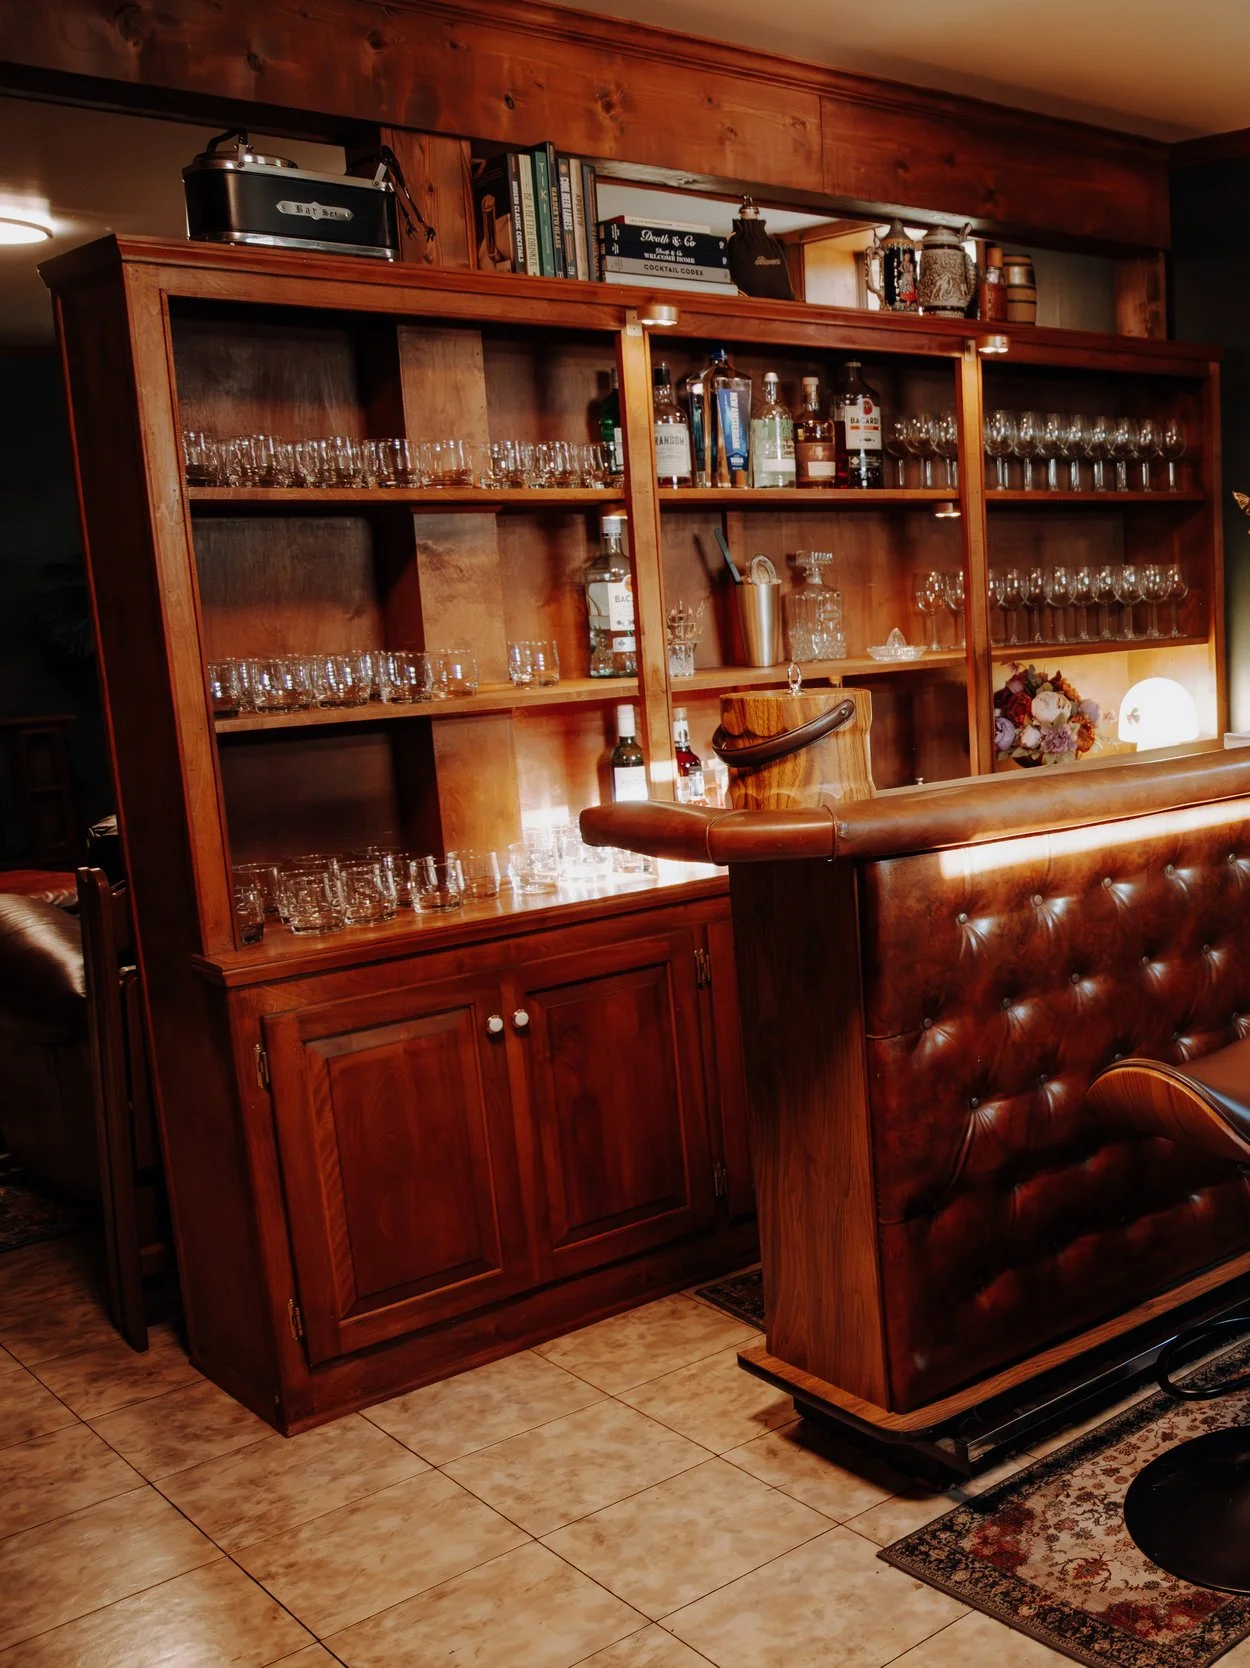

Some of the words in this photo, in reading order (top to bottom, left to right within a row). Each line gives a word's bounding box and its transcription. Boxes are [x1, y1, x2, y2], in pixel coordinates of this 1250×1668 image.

[512, 180, 520, 205] MODERN
[539, 162, 547, 214] TIKI
[560, 176, 570, 192] COOL
[295, 204, 317, 215] Bar
[322, 208, 338, 218] Set
[514, 205, 522, 231] CLASSIC
[515, 231, 525, 263] COCKTAILS
[554, 226, 562, 249] GLASS
[640, 229, 670, 245] Death
[672, 236, 682, 247] &
[684, 235, 697, 247] Co
[643, 252, 676, 262] WELCOME
[676, 256, 696, 264] HOME
[644, 264, 680, 273] COCKTAIL
[680, 267, 704, 276] CODEX
